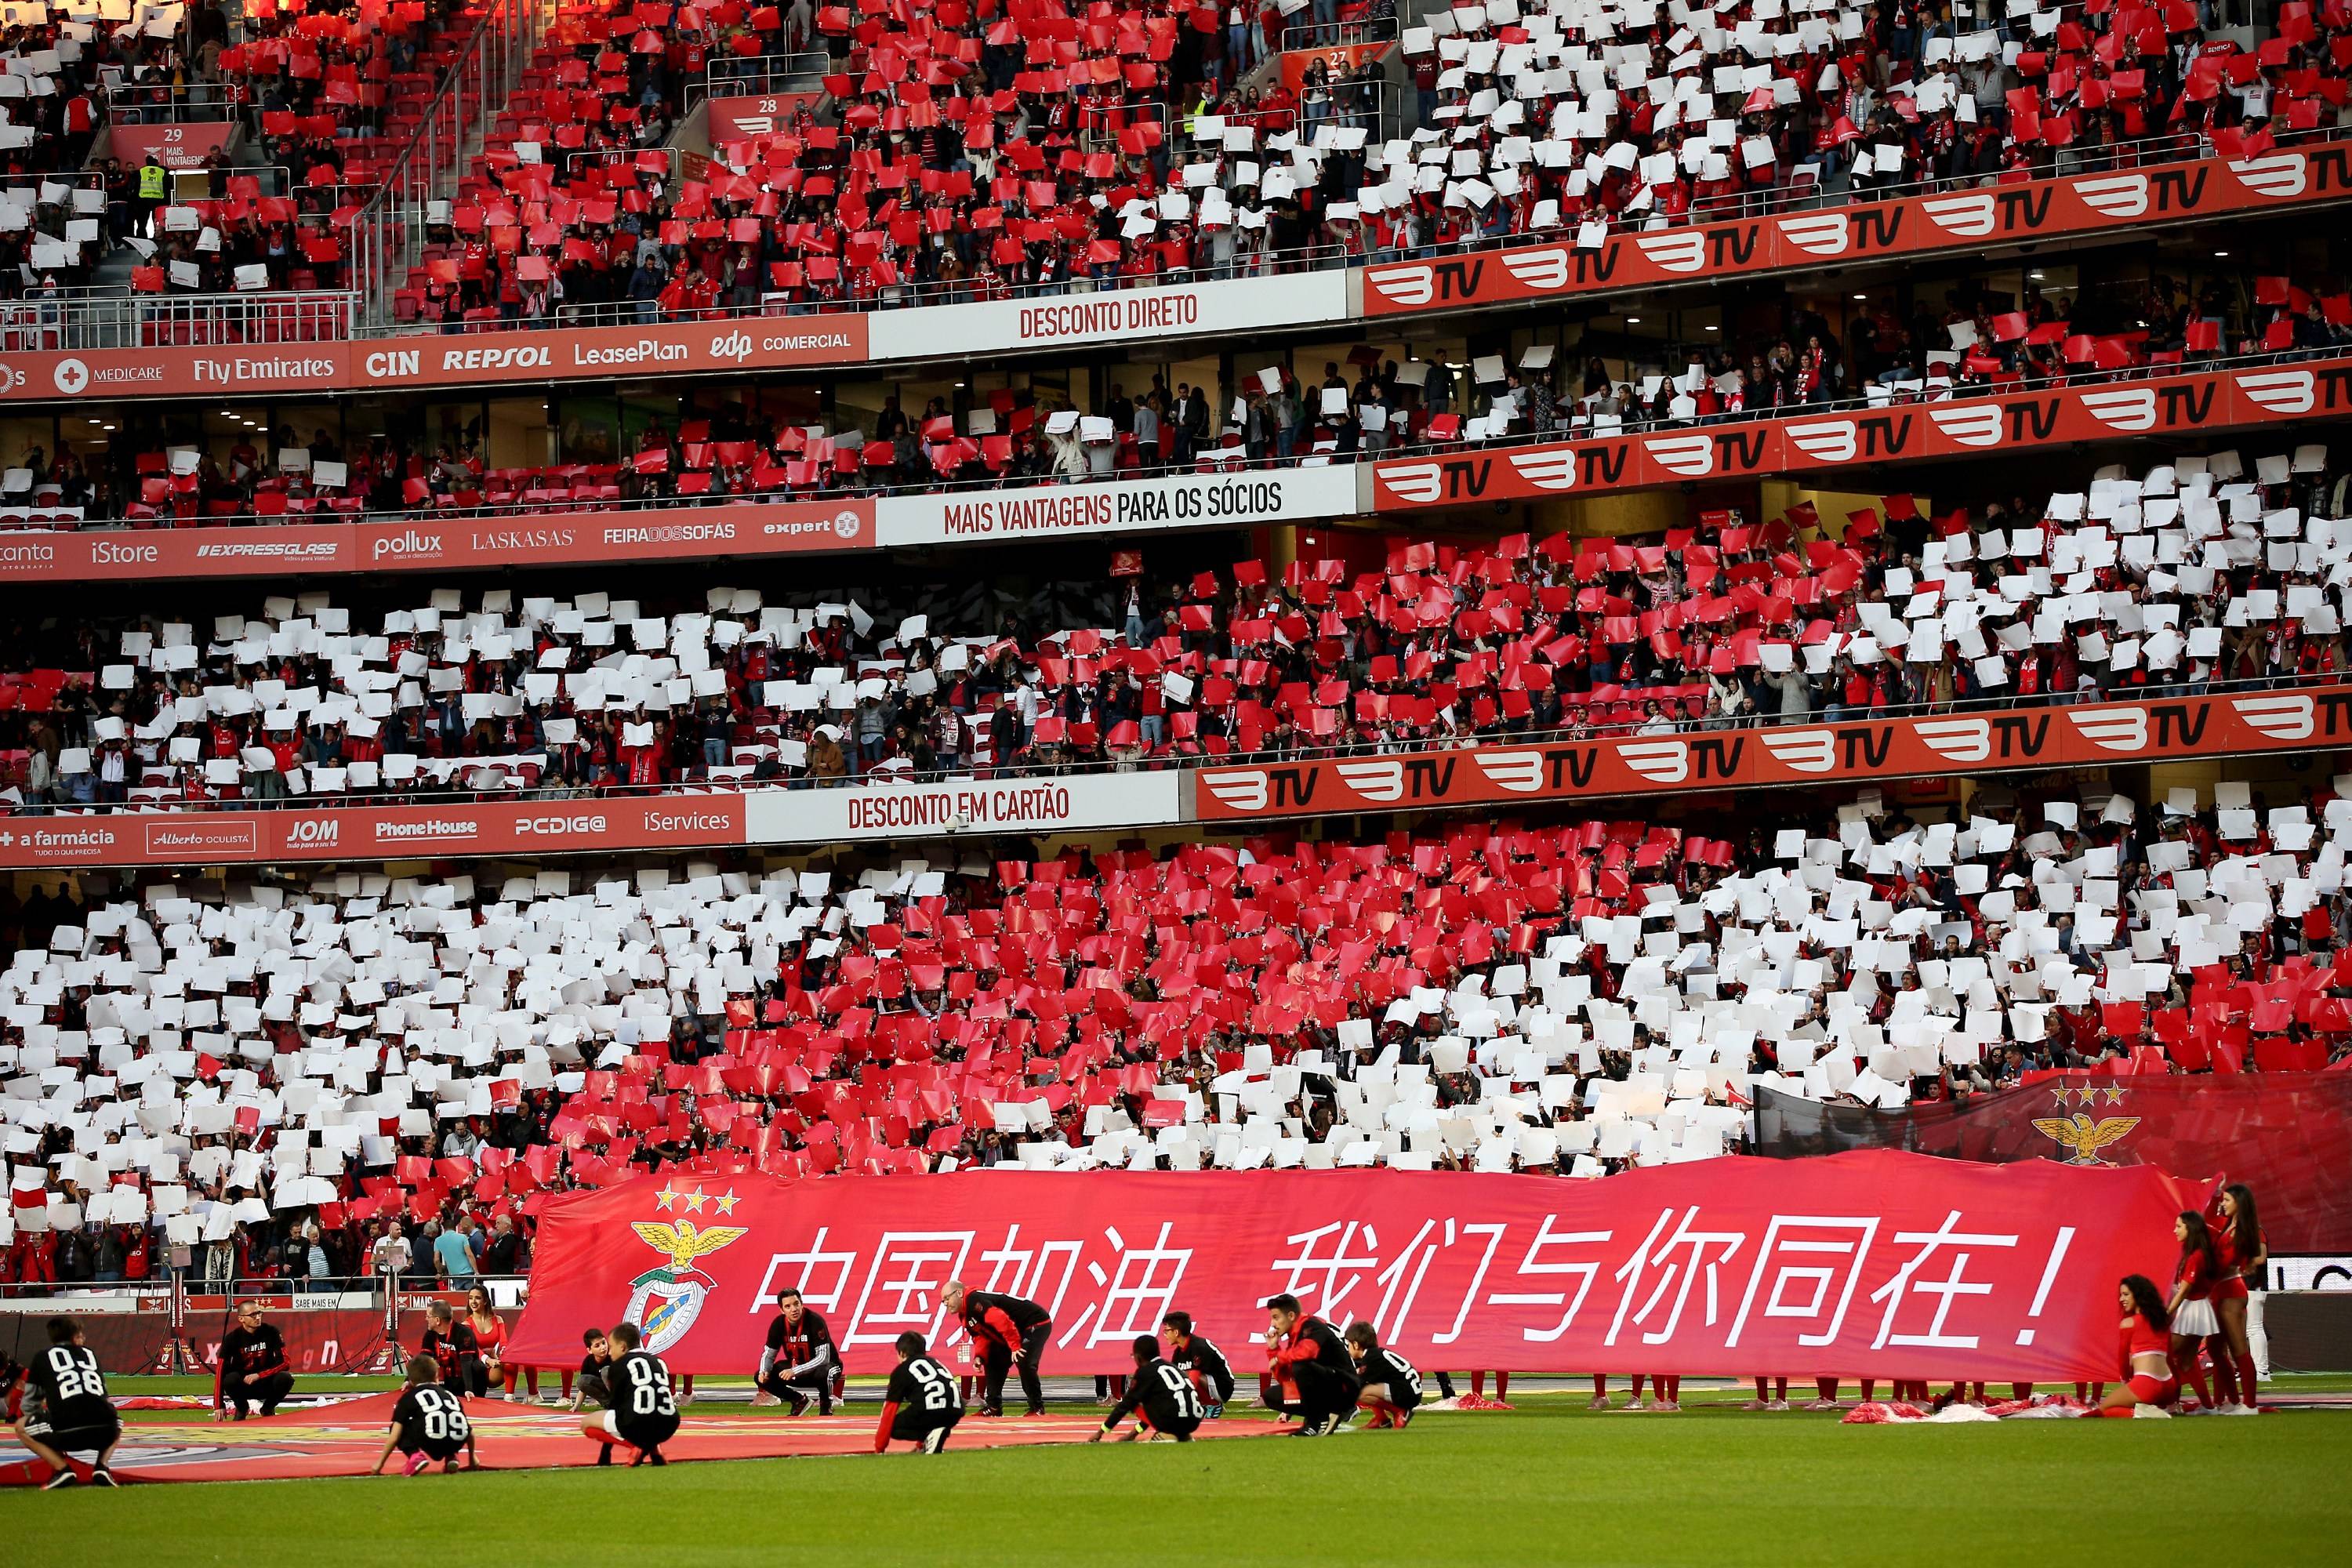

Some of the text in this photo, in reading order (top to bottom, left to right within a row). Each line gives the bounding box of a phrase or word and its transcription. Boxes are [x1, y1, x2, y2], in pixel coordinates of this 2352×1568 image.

[1330, 51, 1347, 66] 27
[759, 100, 777, 113] 28
[164, 129, 183, 142] 29
[166, 147, 183, 155] MAIS
[1020, 294, 1197, 339] DESCONTO DIRETO
[574, 339, 688, 365] LeasePlan
[710, 329, 851, 363] edp COMERCIAL
[365, 350, 420, 378] CIN
[443, 346, 552, 370] REPSOL
[93, 366, 162, 382] MEDICARE
[194, 357, 335, 385] Fly Emirates
[944, 477, 1282, 535] MAIS VANTAGENS PARA OS SÓCIOS
[472, 528, 573, 550] LASKASAS
[764, 520, 830, 535] expert
[91, 542, 158, 563] iStore
[209, 543, 338, 557] EXPRESSGLASS
[374, 530, 443, 560] pollux
[848, 782, 1069, 829] DESCONTO EM CARTÃO
[286, 820, 339, 841] JOM
[644, 811, 730, 831] iServices
[20, 828, 114, 847] a farmácia
[153, 832, 249, 845] Alberto OCULISTA
[748, 1221, 1194, 1352] 中国加油
[295, 1298, 336, 1308] SABE MAIS EM
[56, 1370, 104, 1400] 28
[924, 1381, 962, 1411] 21
[633, 1385, 676, 1416] 03
[424, 1409, 469, 1441] 09
